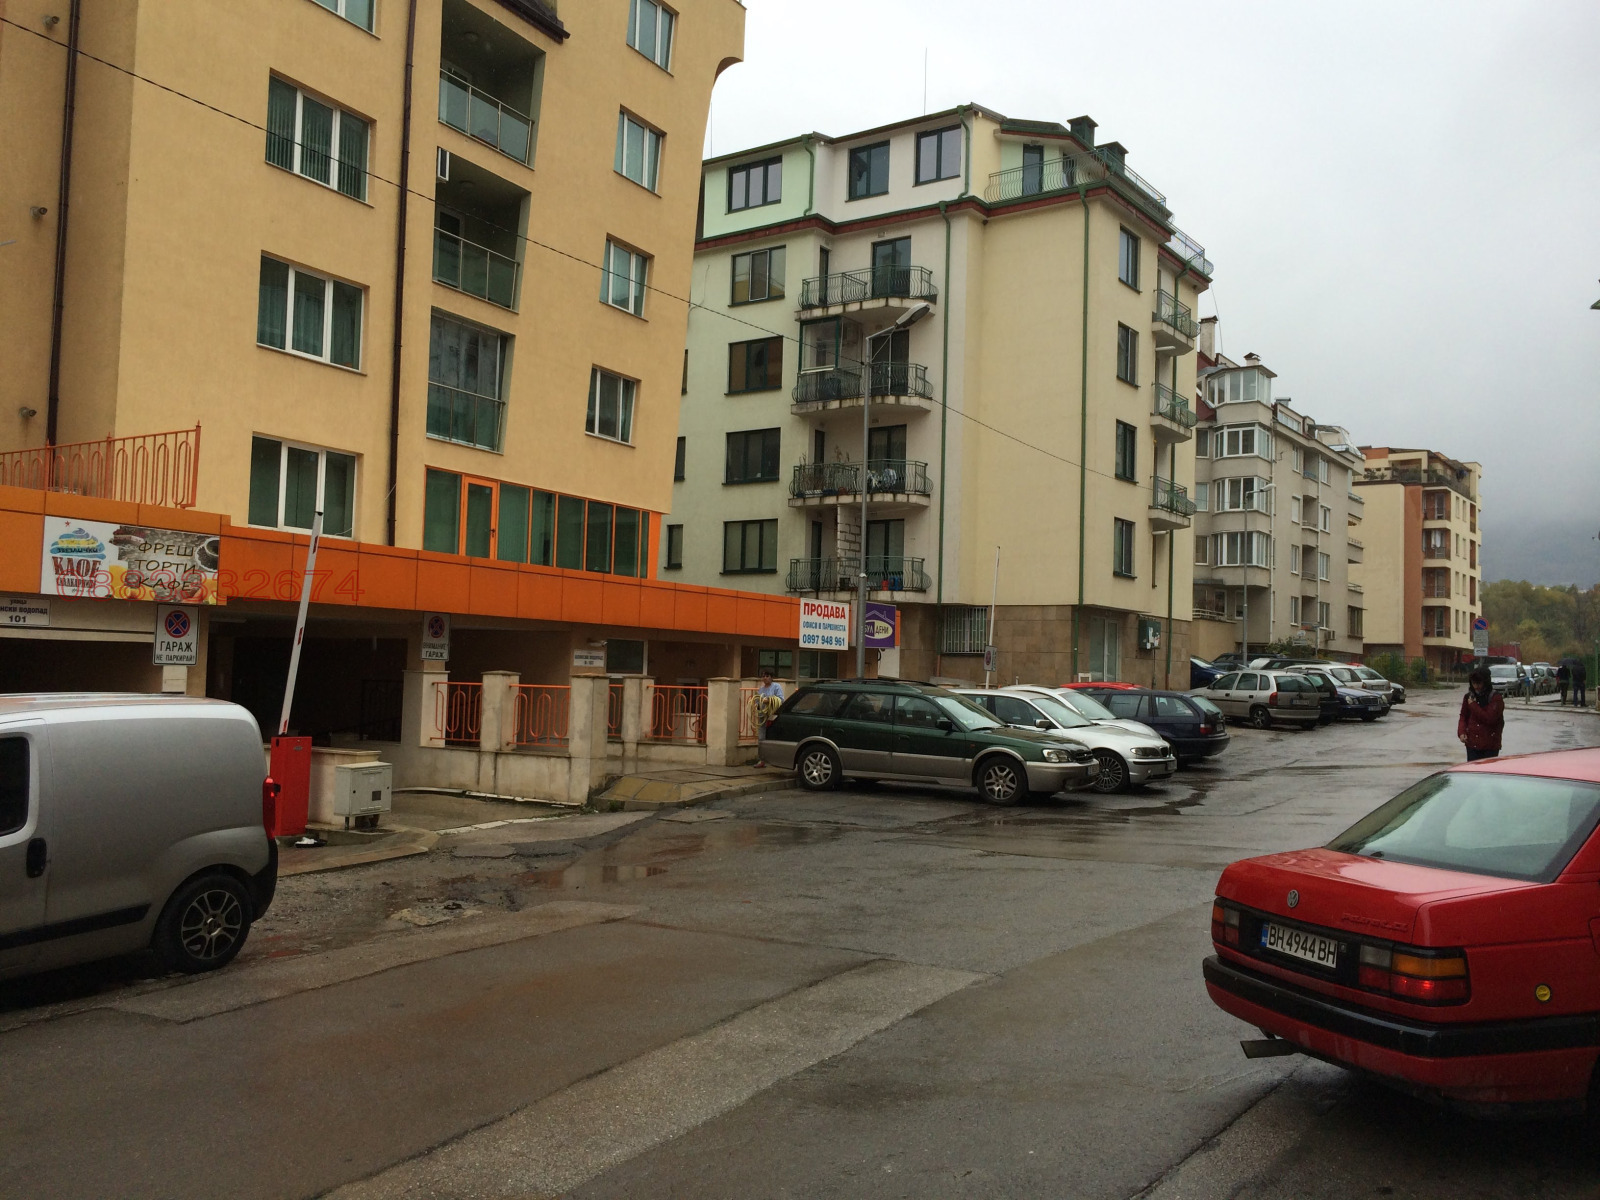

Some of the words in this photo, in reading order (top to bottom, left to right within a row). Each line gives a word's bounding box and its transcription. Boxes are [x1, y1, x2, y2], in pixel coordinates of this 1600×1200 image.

[138, 541, 195, 556] ФРЕШ
[134, 559, 197, 574] ТОРТИ
[138, 576, 193, 592] КАФЕ
[804, 602, 846, 619] ПРОДАВА
[8, 614, 27, 623] 101
[802, 634, 820, 644] 0897
[821, 635, 834, 646] 948
[834, 636, 844, 646] 961
[160, 641, 193, 653] ГАРАЖ
[155, 653, 163, 662] НЕ
